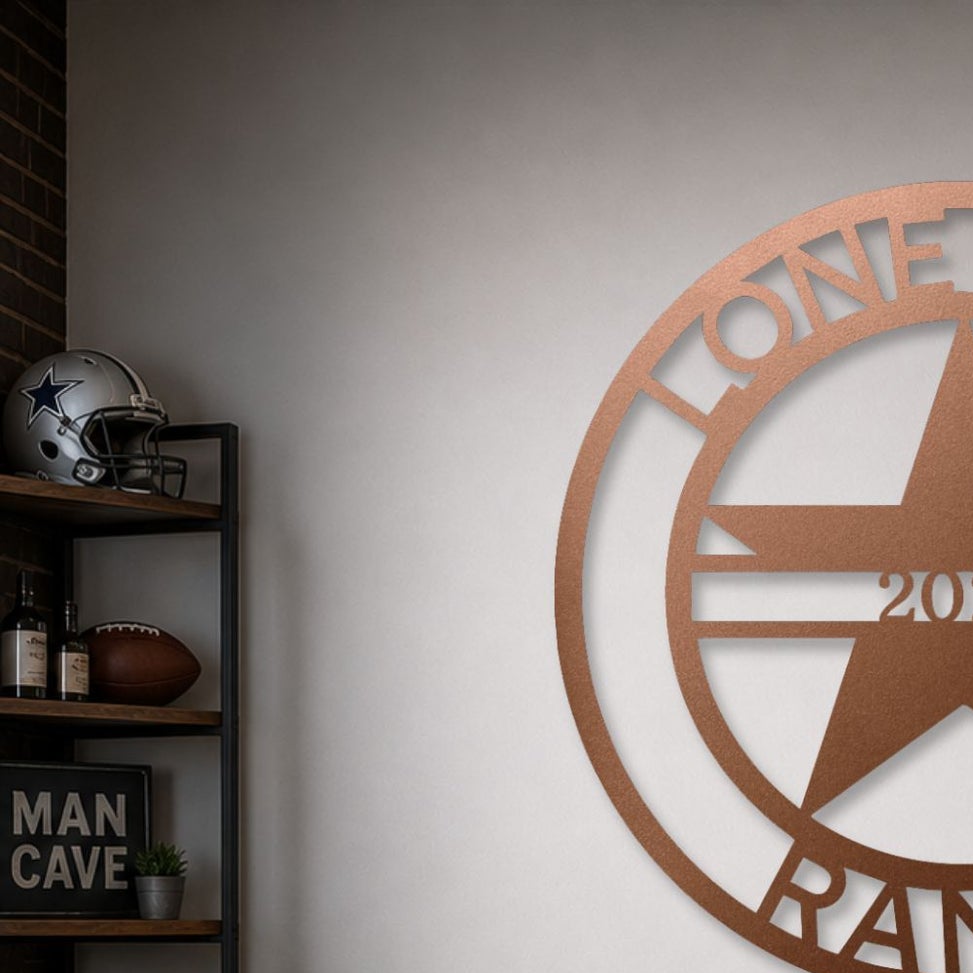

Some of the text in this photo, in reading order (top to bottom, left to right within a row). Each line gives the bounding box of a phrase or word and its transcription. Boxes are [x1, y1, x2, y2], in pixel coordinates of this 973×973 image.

[638, 209, 954, 437] LONE
[12, 790, 127, 838] MAN
[11, 845, 128, 890] CAVE
